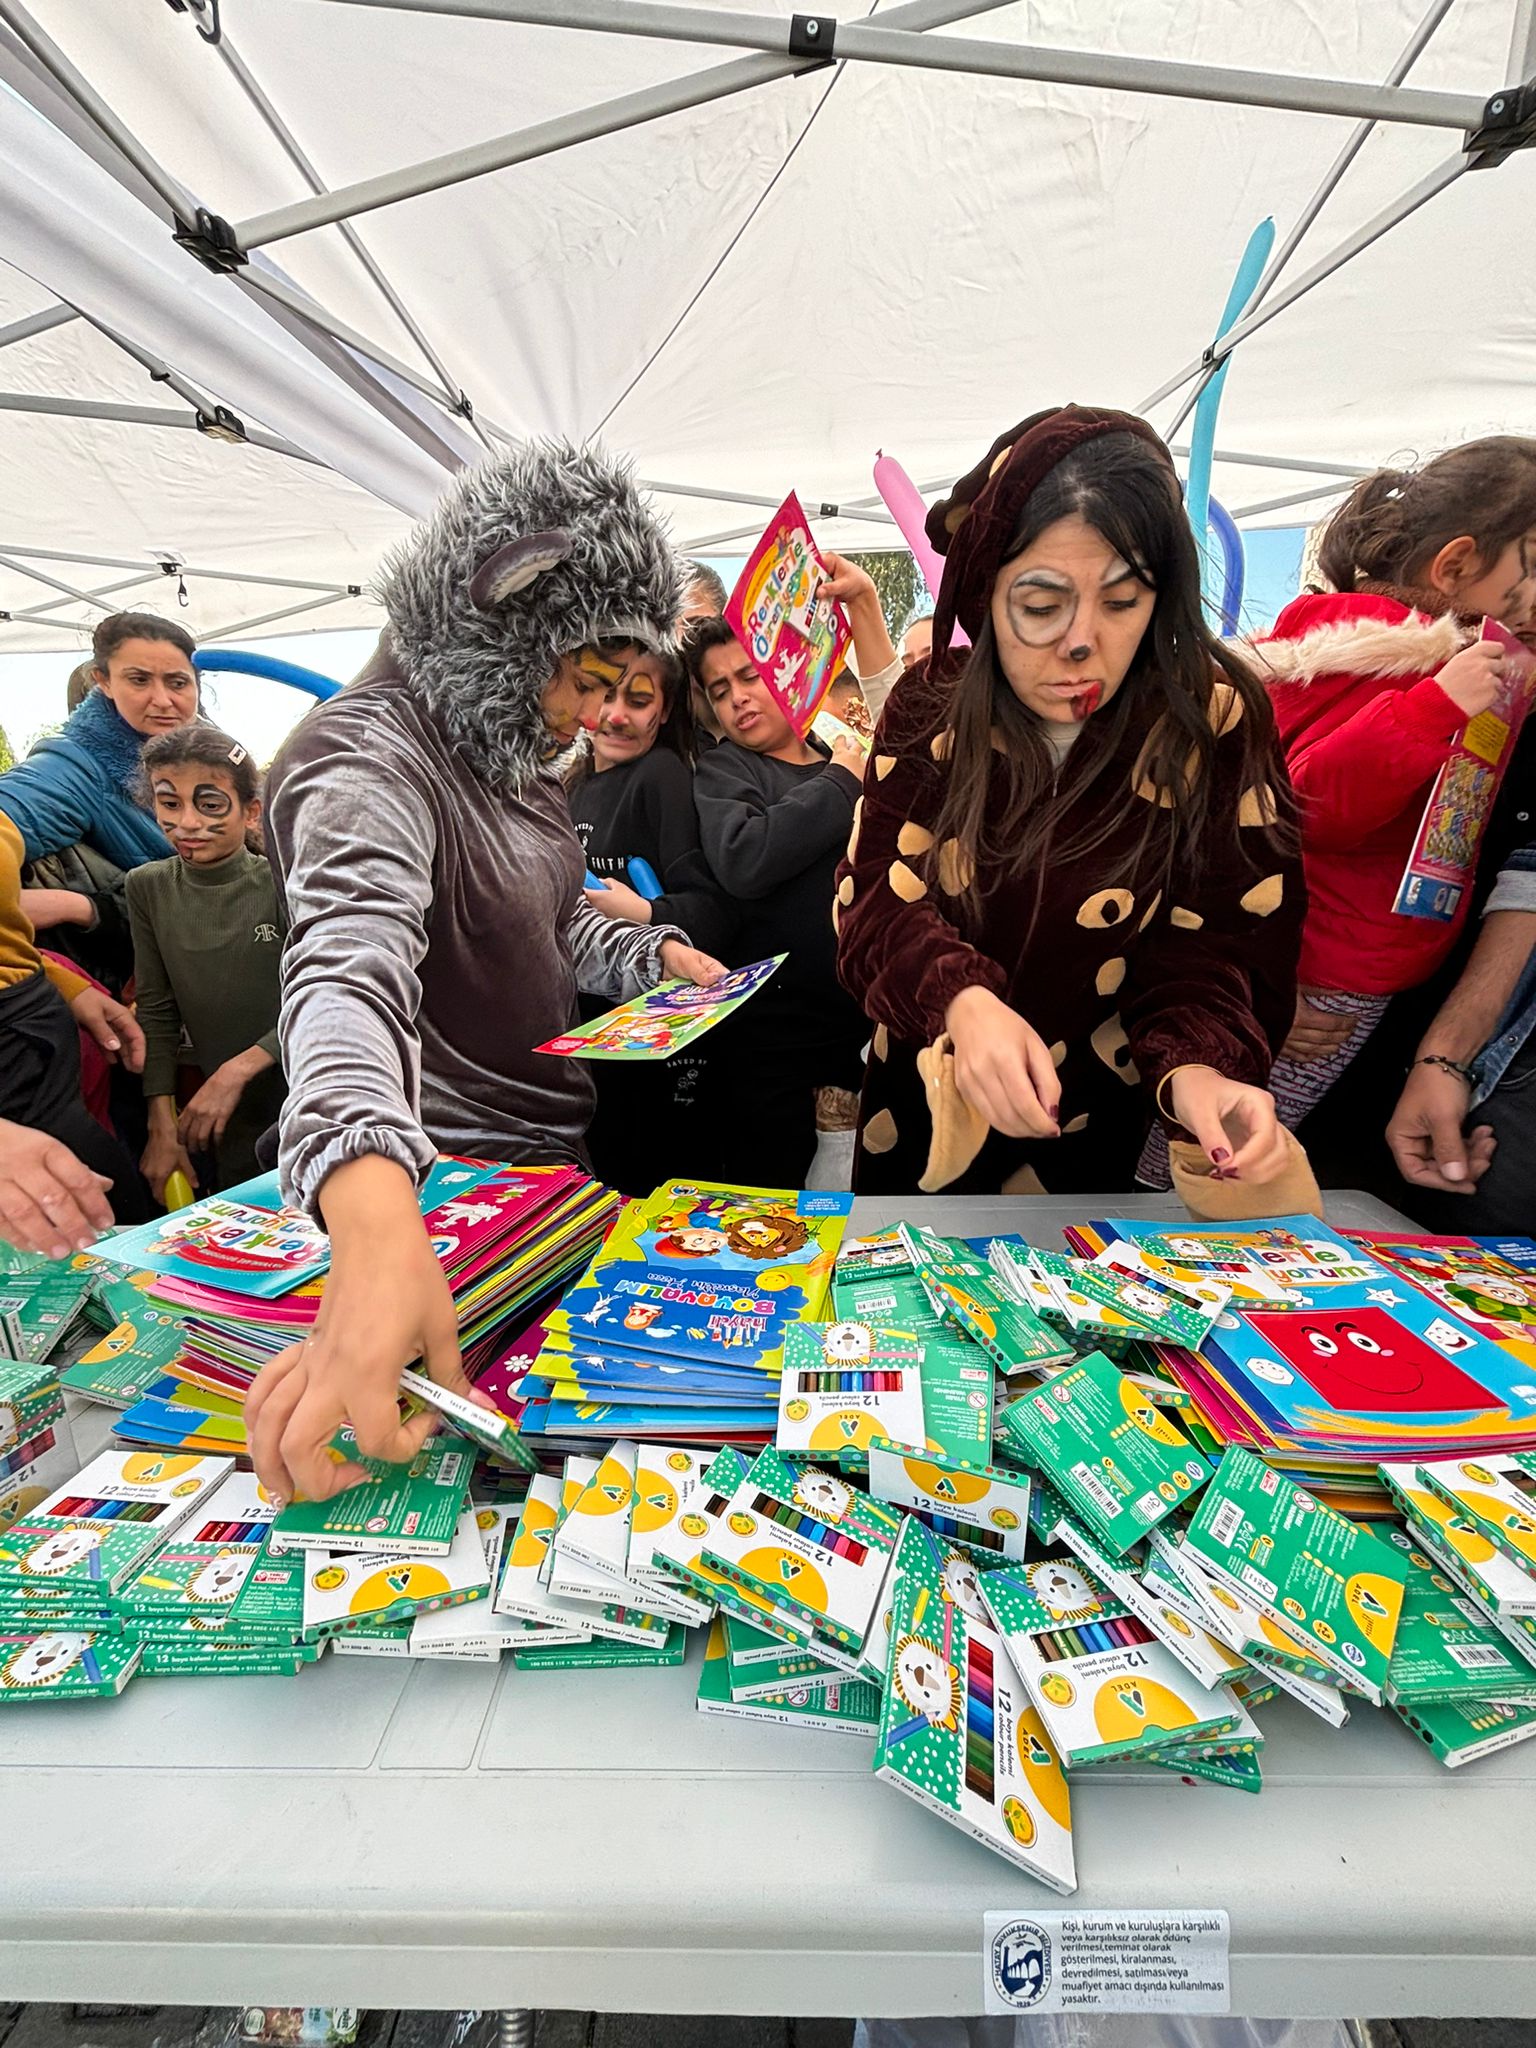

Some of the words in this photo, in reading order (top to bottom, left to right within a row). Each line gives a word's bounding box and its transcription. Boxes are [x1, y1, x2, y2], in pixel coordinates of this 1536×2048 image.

[748, 541, 803, 635] Renklerle
[185, 1216, 324, 1263] Renklerle
[1242, 1245, 1341, 1265] lerle
[615, 1279, 775, 1315] BOYAYALIM
[707, 1314, 767, 1331] haydi
[863, 1395, 880, 1406] 12
[1131, 1411, 1150, 1431] ADEL
[98, 1485, 119, 1495] 12
[934, 1491, 958, 1501] ADEL
[618, 1488, 629, 1505] ADEL
[912, 1496, 930, 1508] 12
[241, 1508, 260, 1518] 12
[783, 1551, 806, 1568] ADEL
[815, 1549, 834, 1567] 12
[384, 1567, 412, 1577] ADEL
[1352, 1582, 1362, 1604] ADEL
[134, 1604, 145, 1612] 12
[138, 1630, 150, 1639] 12
[156, 1655, 168, 1663] 12
[1073, 1658, 1100, 1670] pencils
[1123, 1651, 1149, 1668] 12
[1081, 1667, 1108, 1680] kalemi
[1111, 1681, 1138, 1692] ADEL
[998, 1687, 1012, 1713] 12
[1006, 1718, 1014, 1742] boya
[1022, 1728, 1031, 1760] ADEL
[1006, 1743, 1015, 1778] kalemi
[1062, 1921, 1080, 1932] Kişi,
[1083, 1922, 1112, 1931] kurum
[1115, 1923, 1126, 1931] ve
[1128, 1921, 1180, 1934] kuruluşlara
[1183, 1922, 1220, 1933] karşılıklı
[1062, 1935, 1082, 1944] veya
[1085, 1933, 1129, 1944] karşılıksız
[1132, 1933, 1160, 1943] olarak
[1163, 1934, 1191, 1944] ödünç
[1143, 1944, 1171, 1952] olarak
[1061, 1955, 1119, 1966] gösterilmesi,
[1121, 1955, 1177, 1965] kiralanması,
[1061, 1968, 1122, 1979] devredilmesi,
[1167, 1970, 1188, 1979] veya
[1062, 1981, 1102, 1993] muafiyet
[1105, 1982, 1131, 1991] amacı
[1134, 1982, 1167, 1993] dışında
[1170, 1981, 1224, 1991] kullanılması
[1062, 1995, 1101, 2005] yasaktır.
